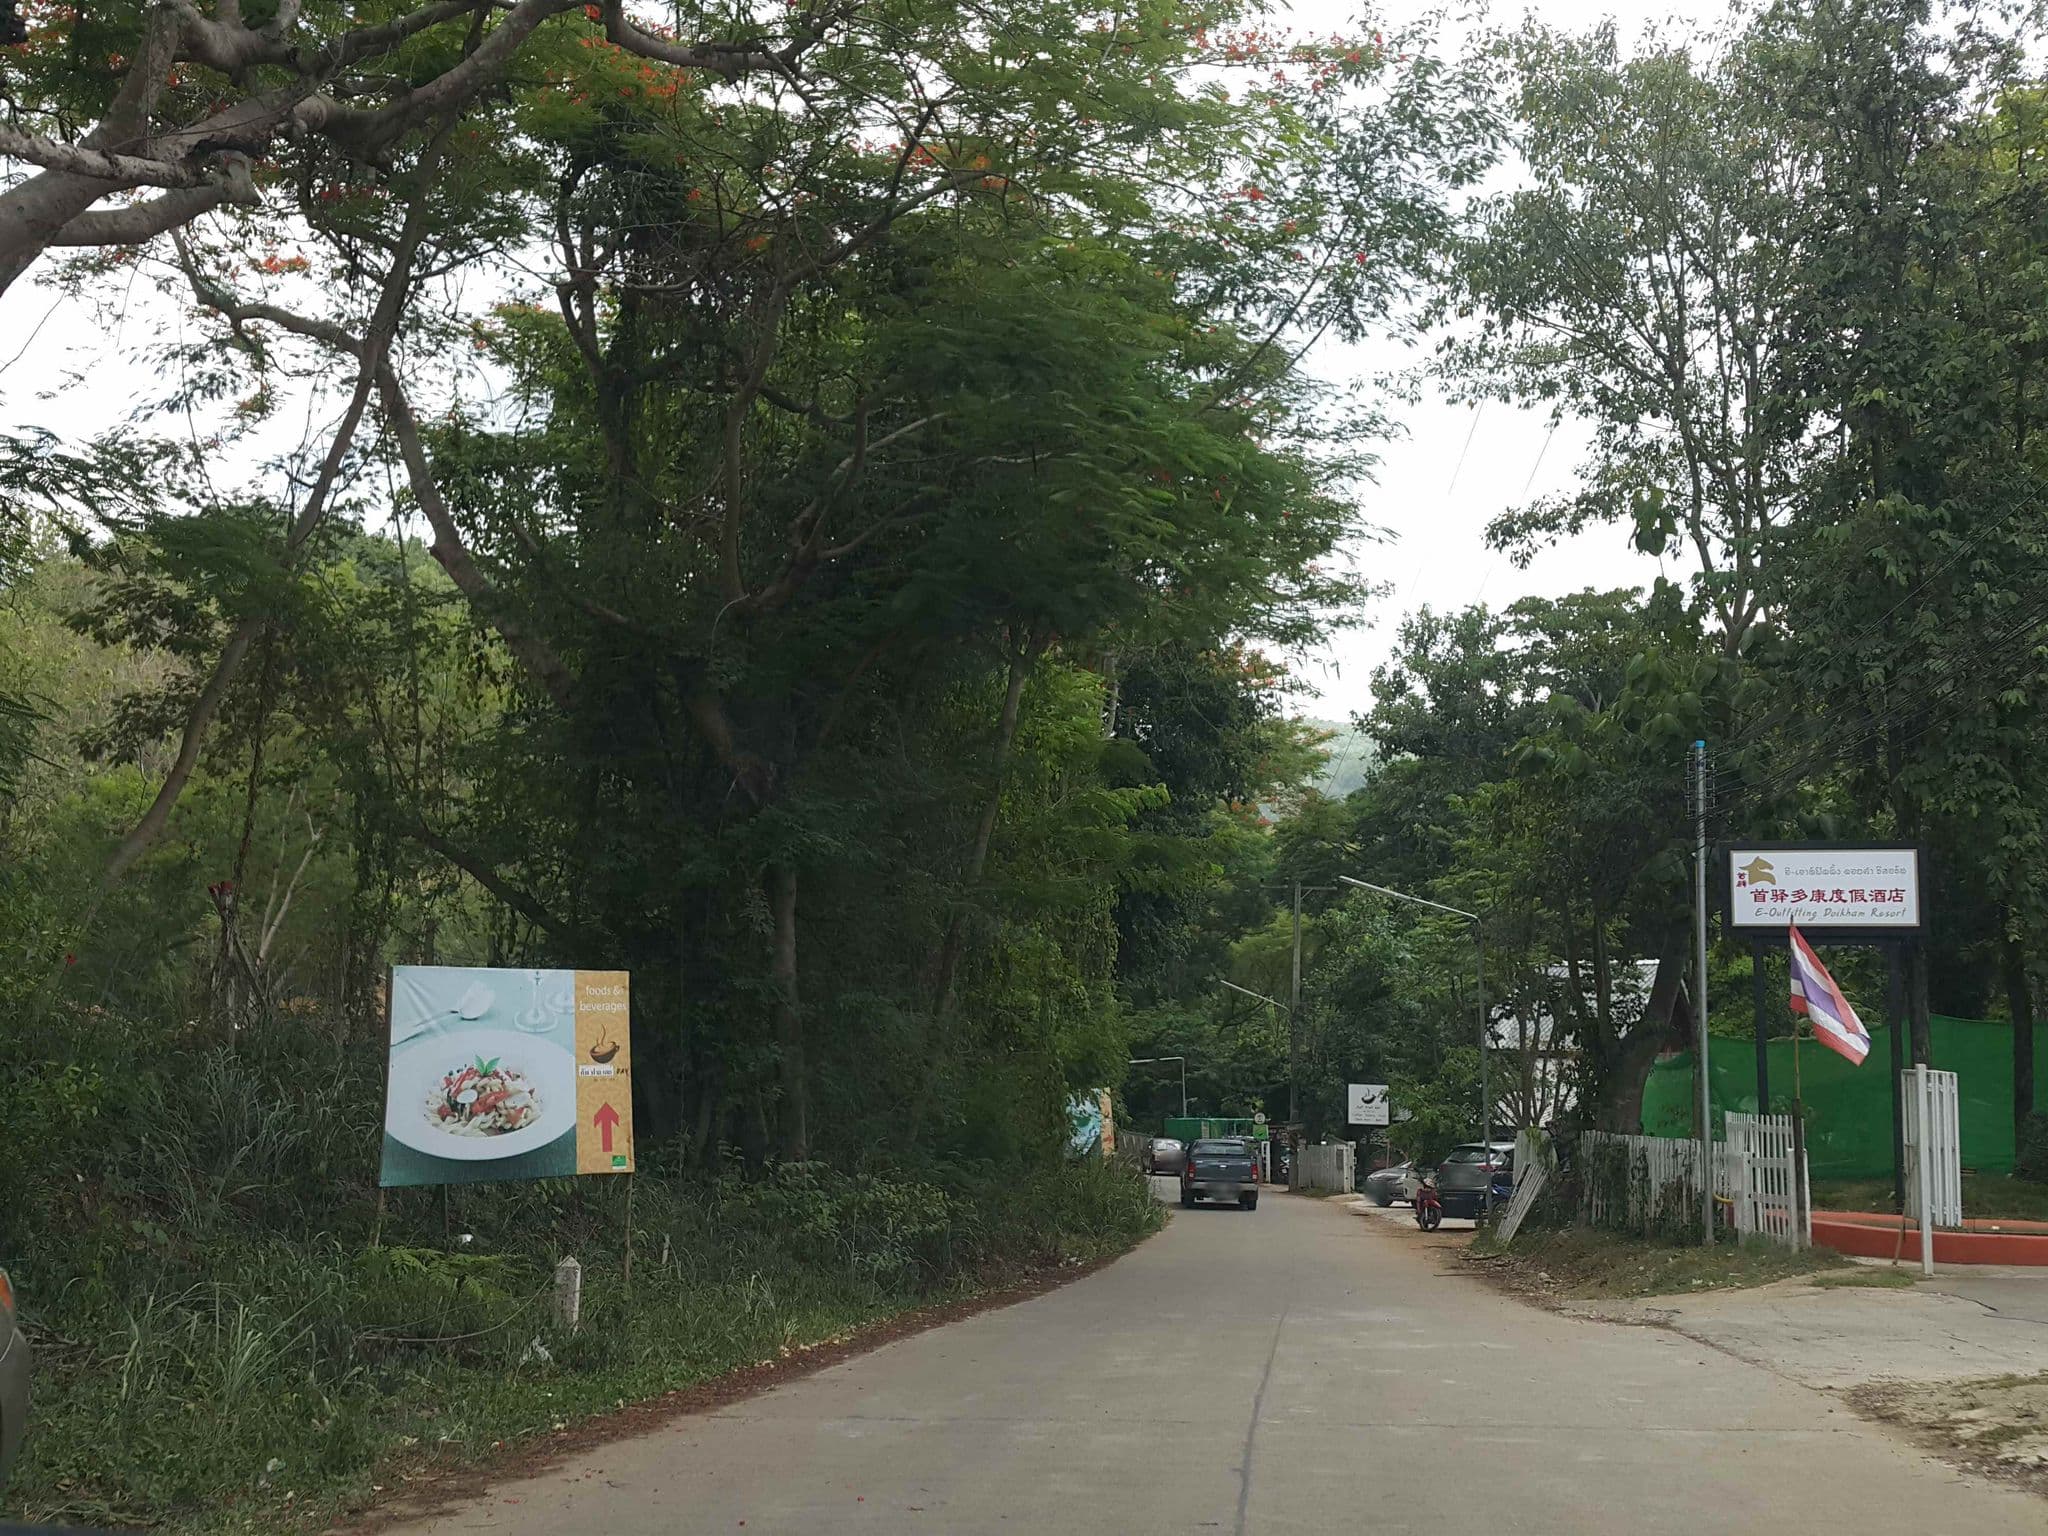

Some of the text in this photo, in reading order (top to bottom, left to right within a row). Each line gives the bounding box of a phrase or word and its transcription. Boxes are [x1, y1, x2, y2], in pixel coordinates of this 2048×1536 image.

[1750, 888, 1906, 903] 首驿多康度假酒店
[1823, 908, 1865, 918] Doikham
[1870, 907, 1907, 918] Resort
[585, 984, 611, 996] foods
[579, 1000, 627, 1014] beverages
